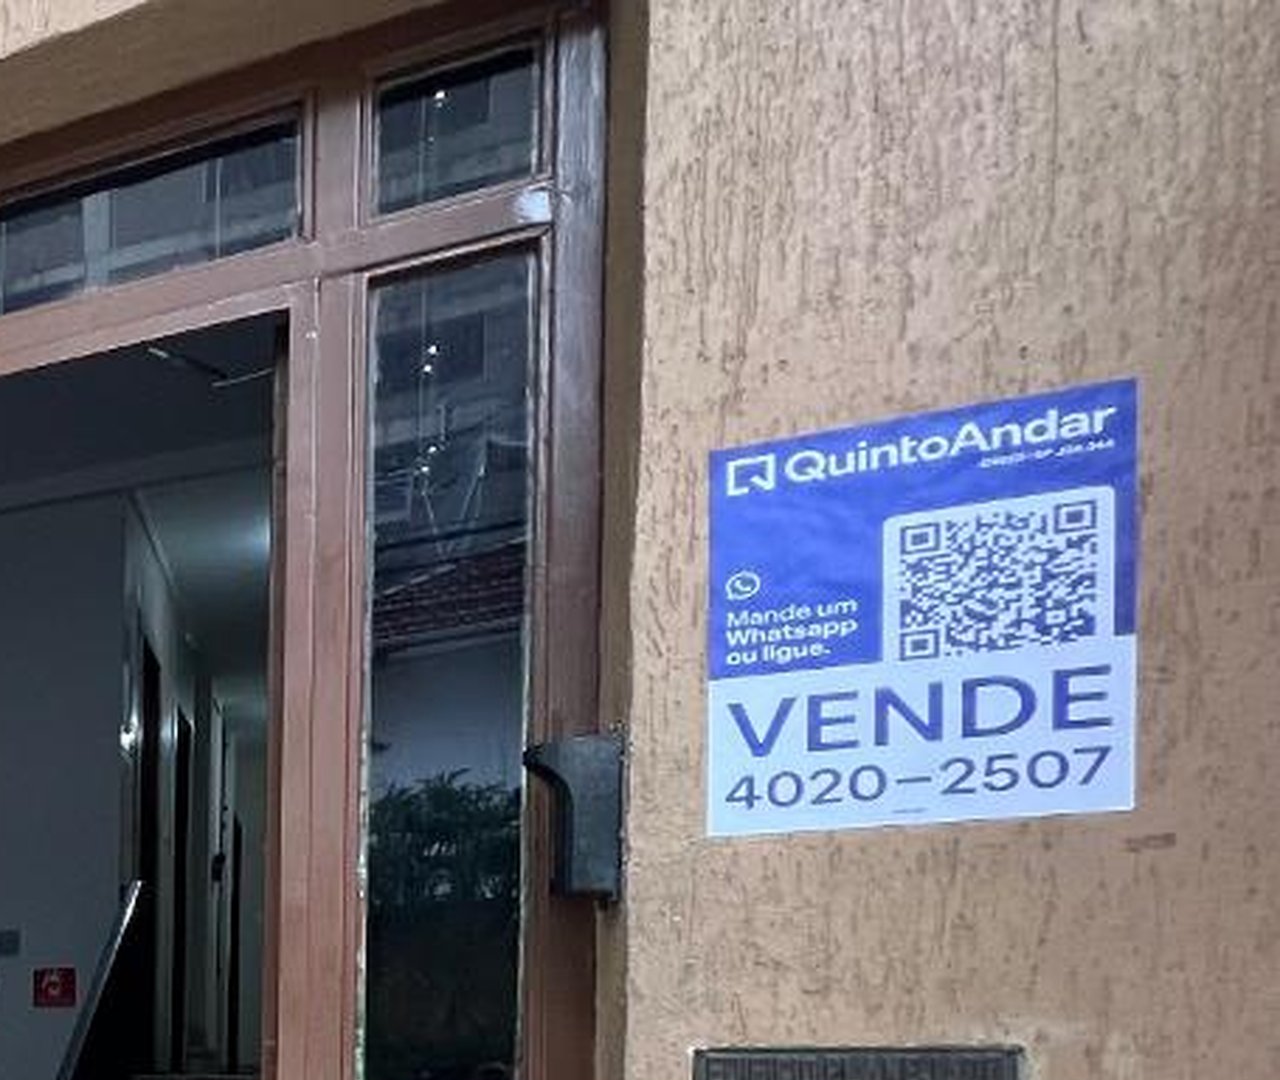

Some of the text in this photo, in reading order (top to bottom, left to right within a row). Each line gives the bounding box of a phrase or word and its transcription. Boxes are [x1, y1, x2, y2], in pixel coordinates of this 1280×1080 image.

[784, 407, 1117, 482] QuintoAndar
[726, 619, 858, 647] Whatsapp
[727, 599, 858, 628] Mande um
[726, 642, 831, 665] ou ligue.
[727, 664, 1113, 758] VENDE
[725, 745, 1113, 811] 4020-2507
